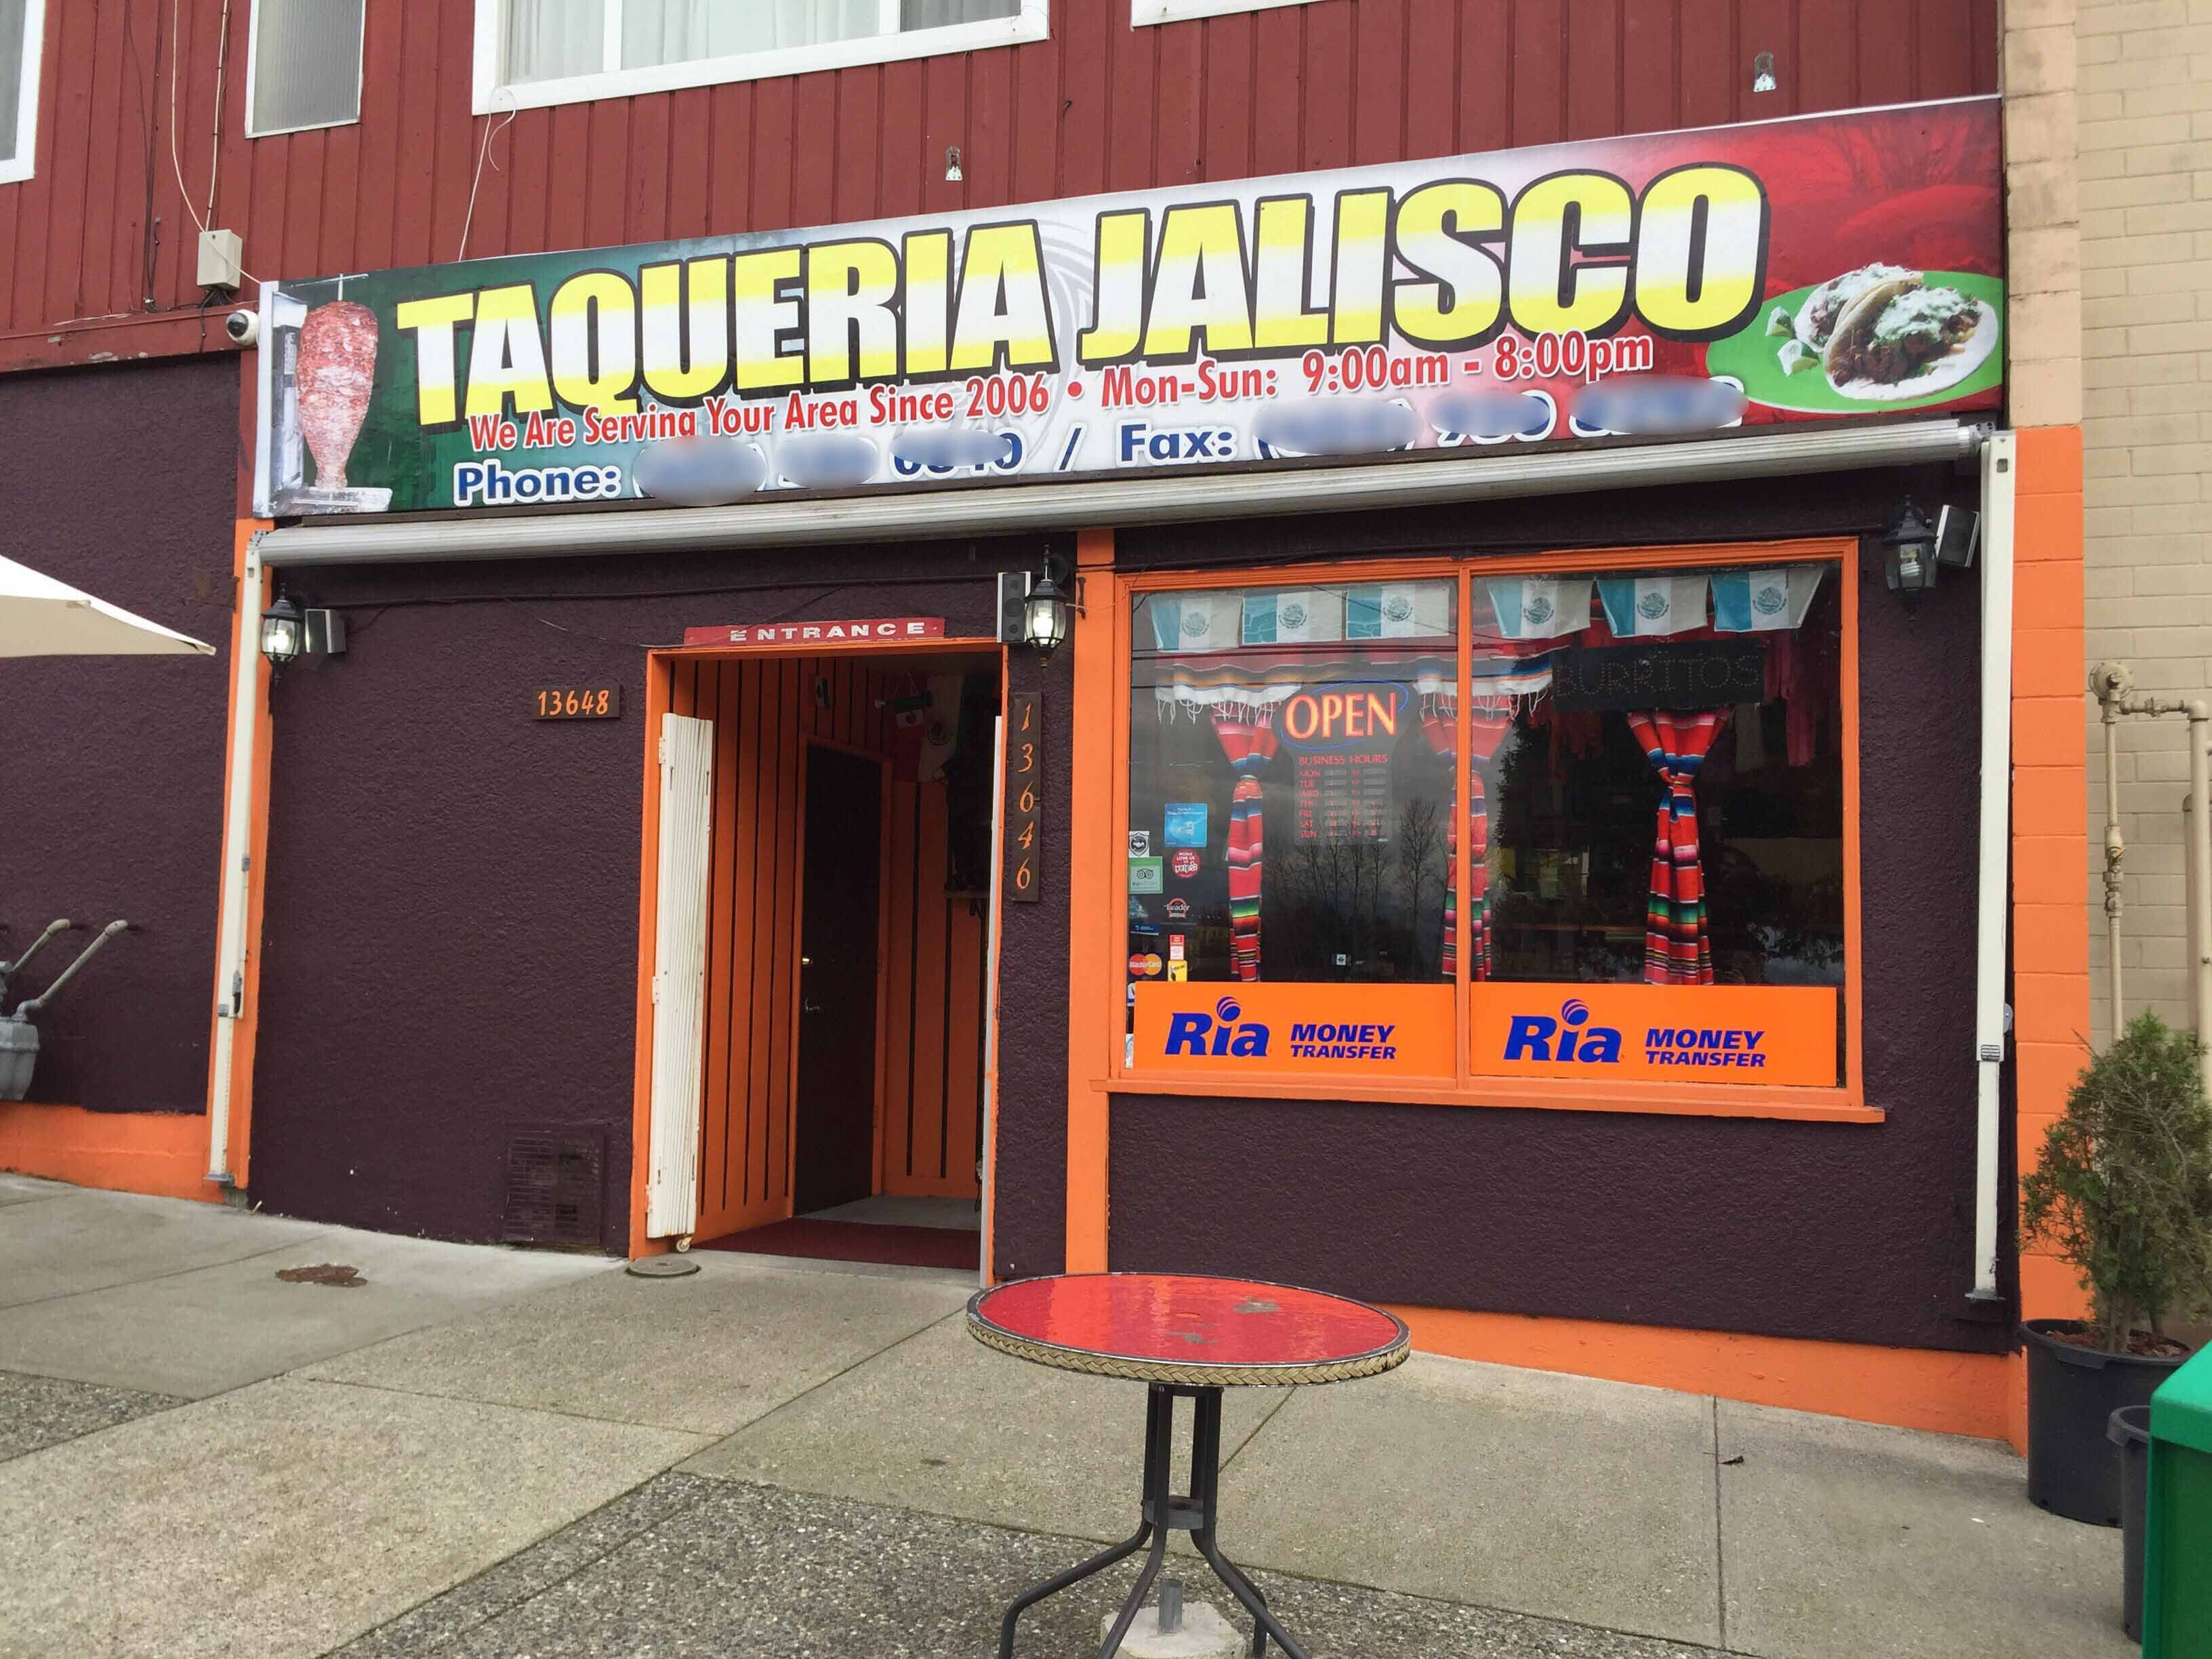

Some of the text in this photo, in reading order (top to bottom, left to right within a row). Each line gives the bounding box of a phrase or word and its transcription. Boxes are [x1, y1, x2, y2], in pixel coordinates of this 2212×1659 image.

[396, 163, 1768, 430] TAQUERIA JALISCO
[470, 414, 516, 450] We
[525, 411, 573, 447] Are
[704, 397, 775, 435] Your
[785, 394, 858, 429] Area
[869, 384, 950, 424] Since
[966, 373, 1049, 417] 2006
[1102, 360, 1277, 407] Mon-Sun:
[1303, 349, 1449, 393] 9:00am
[1495, 331, 1653, 381] 8:00pm
[458, 463, 620, 501] Phone:
[1121, 424, 1233, 462] Fax:
[731, 623, 926, 642] ENTRANCE
[1555, 654, 1761, 697] BURRITOS
[538, 689, 610, 716] 13648
[1285, 692, 1397, 740] OPEN
[1298, 754, 1389, 765] BUSINESS HOURS
[1017, 703, 1033, 889] 13646
[1166, 903, 1191, 911] Leader
[1164, 996, 1396, 1057] Ria MONEY
[1504, 999, 1765, 1063] Ria MONEY
[1290, 1044, 1397, 1060] TRANSFER
[1645, 1050, 1766, 1067] TRANSFER
